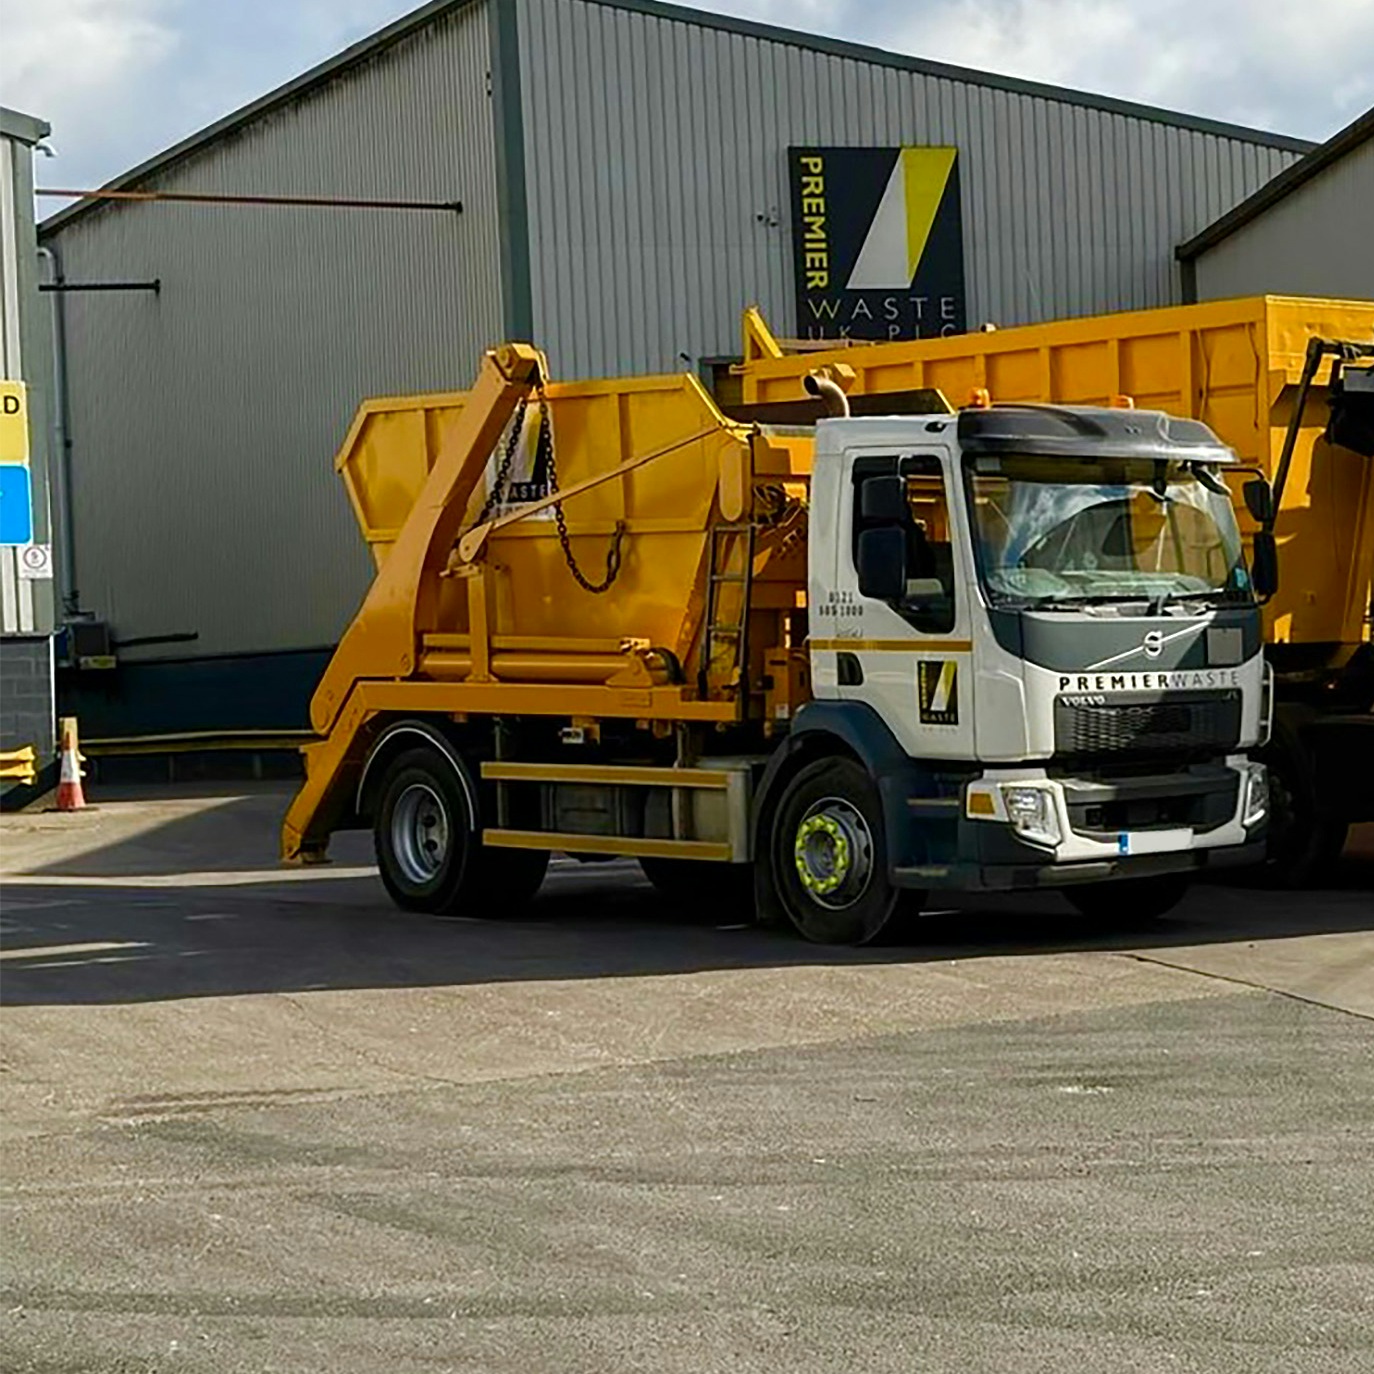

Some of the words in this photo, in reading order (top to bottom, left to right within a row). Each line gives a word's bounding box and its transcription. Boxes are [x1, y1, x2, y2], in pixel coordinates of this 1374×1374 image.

[801, 157, 829, 290] PREMIER
[807, 297, 955, 320] WASTE
[807, 325, 852, 340] UK
[0, 395, 20, 414] D
[500, 484, 547, 500] ASTE
[1059, 674, 1169, 691] PREMIER
[1169, 670, 1239, 688] WASTE
